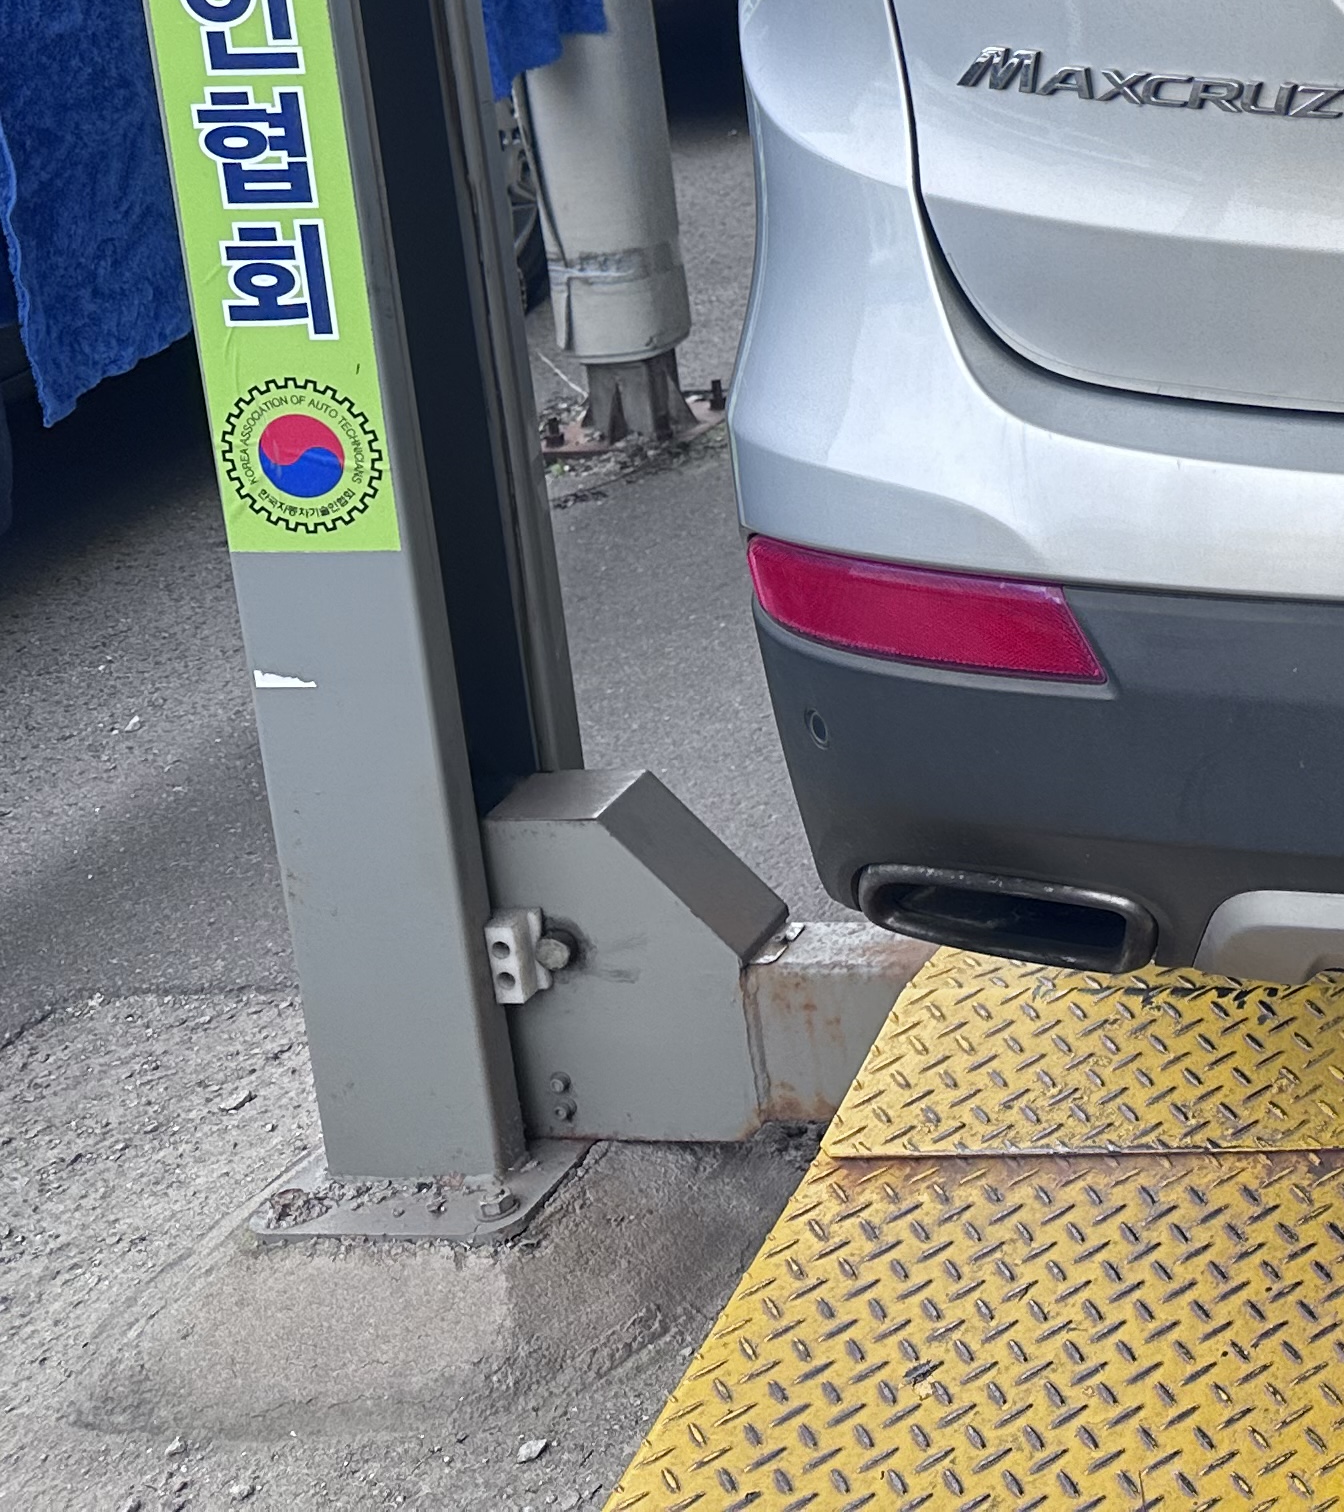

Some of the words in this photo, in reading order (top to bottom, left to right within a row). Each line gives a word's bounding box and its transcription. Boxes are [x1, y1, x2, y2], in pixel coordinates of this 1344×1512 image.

[290, 394, 306, 406] OF
[308, 398, 339, 419] AUTO
[240, 395, 289, 445] ASSOCIATION
[239, 448, 260, 486] KOREA
[338, 416, 365, 485] TECHNICIANS
